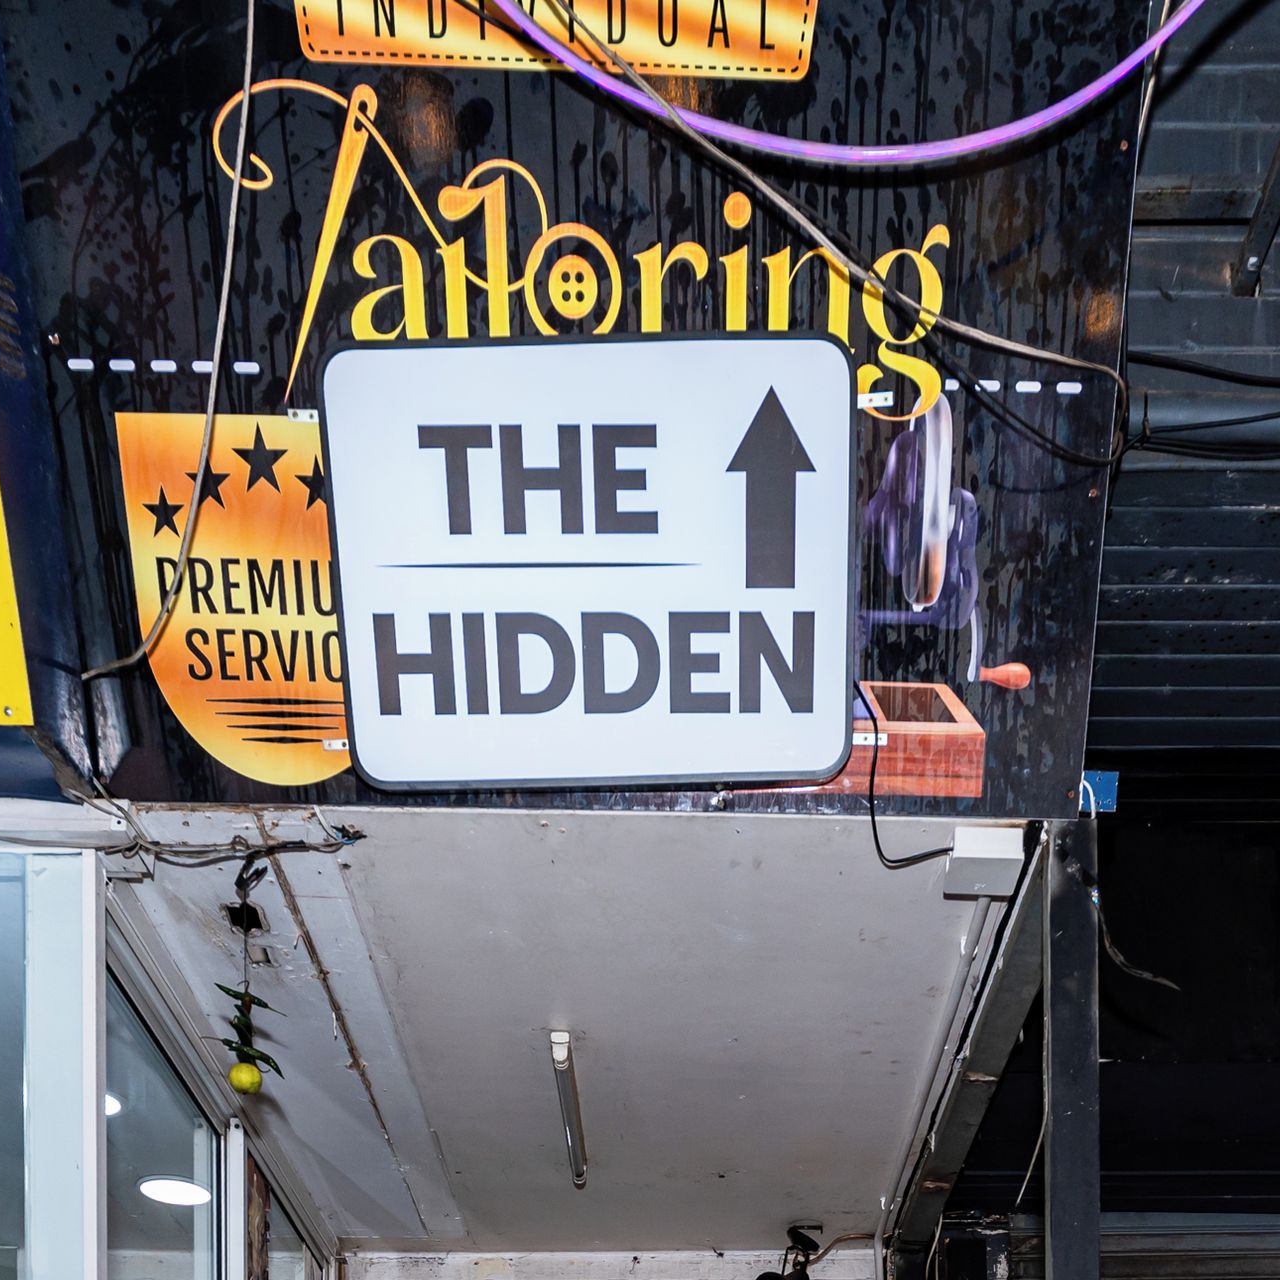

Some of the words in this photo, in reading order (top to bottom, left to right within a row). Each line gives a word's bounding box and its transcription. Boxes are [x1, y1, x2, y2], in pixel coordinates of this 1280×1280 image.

[335, 0, 778, 50] INDIIDUAL
[416, 423, 659, 537] THE
[156, 557, 336, 616] PREMIU
[185, 628, 344, 684] SERVIC
[373, 610, 815, 717] HIDDEN
